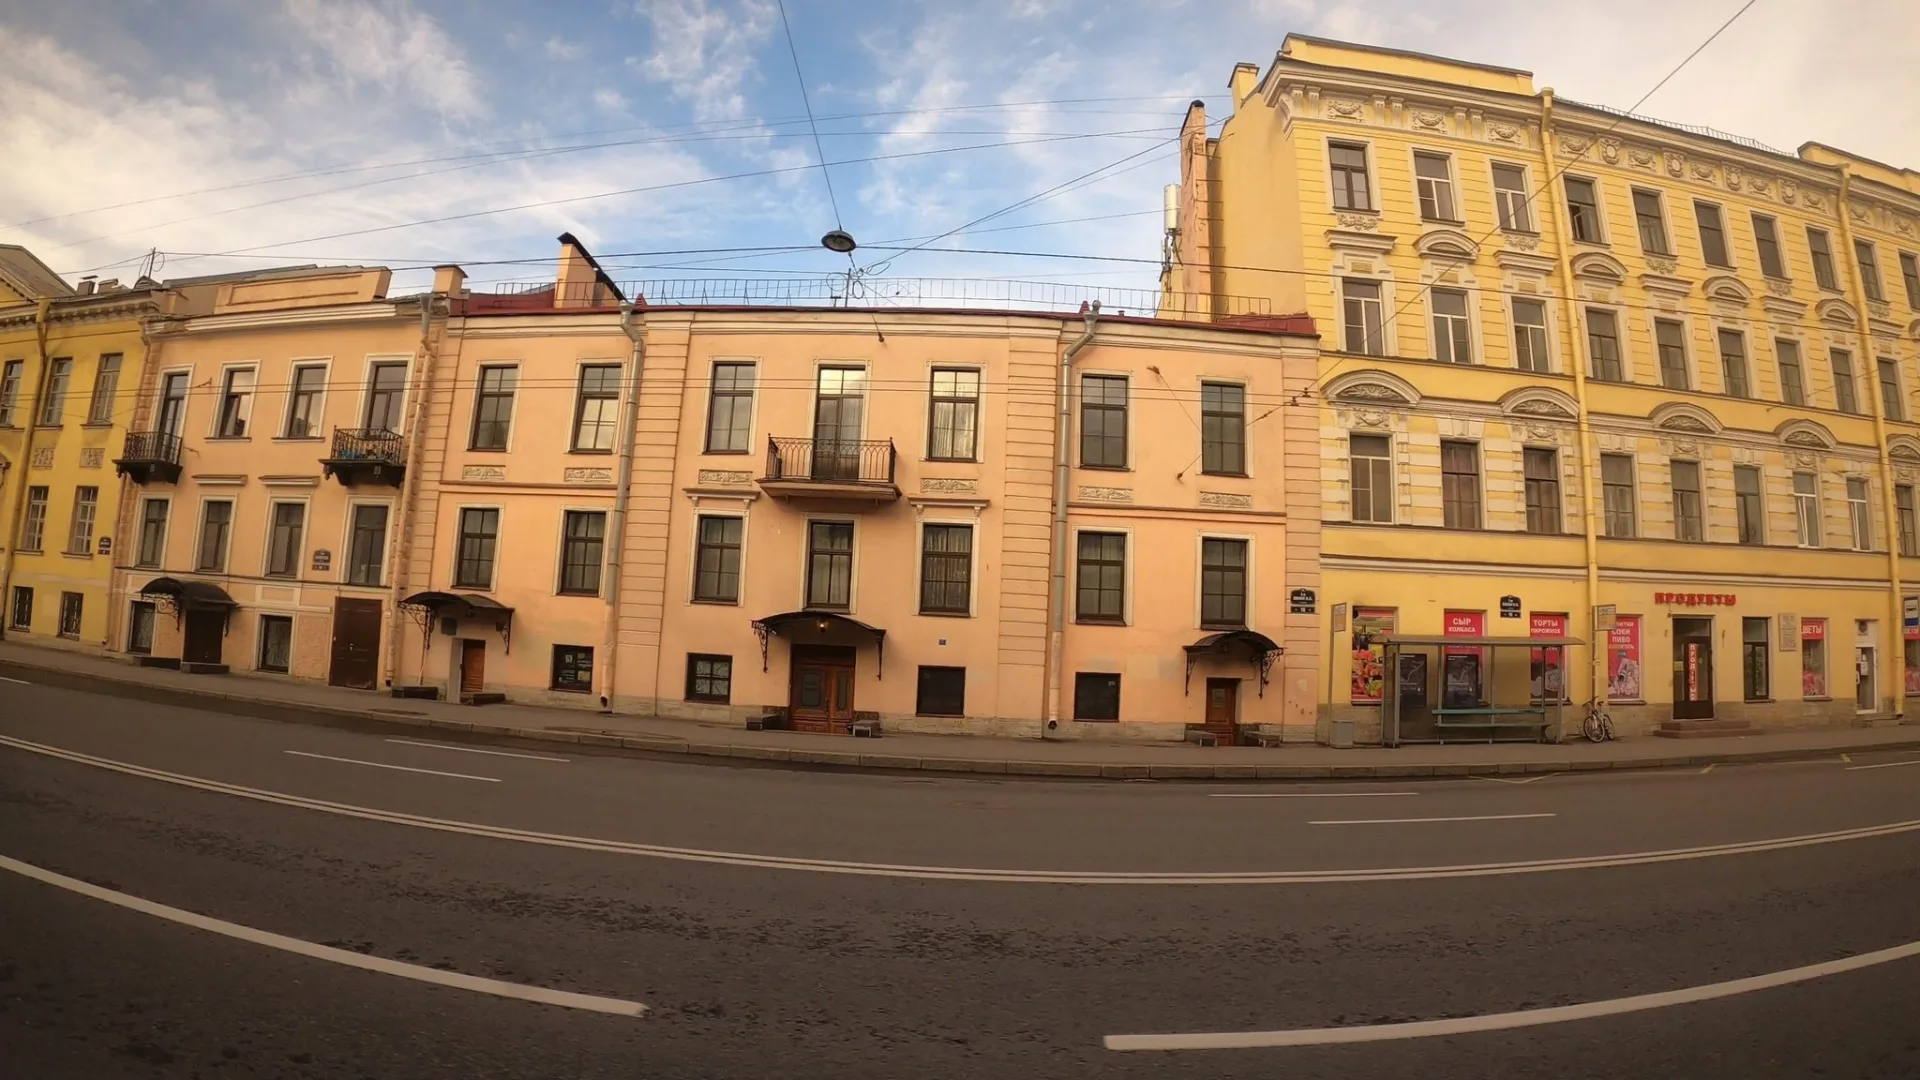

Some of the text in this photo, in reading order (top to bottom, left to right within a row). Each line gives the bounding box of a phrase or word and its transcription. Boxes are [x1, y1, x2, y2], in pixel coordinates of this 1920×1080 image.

[1655, 592, 1736, 606] ПРОДУКТЫ
[1453, 617, 1471, 626] СЫР
[1533, 619, 1558, 627] ТОРТЫ
